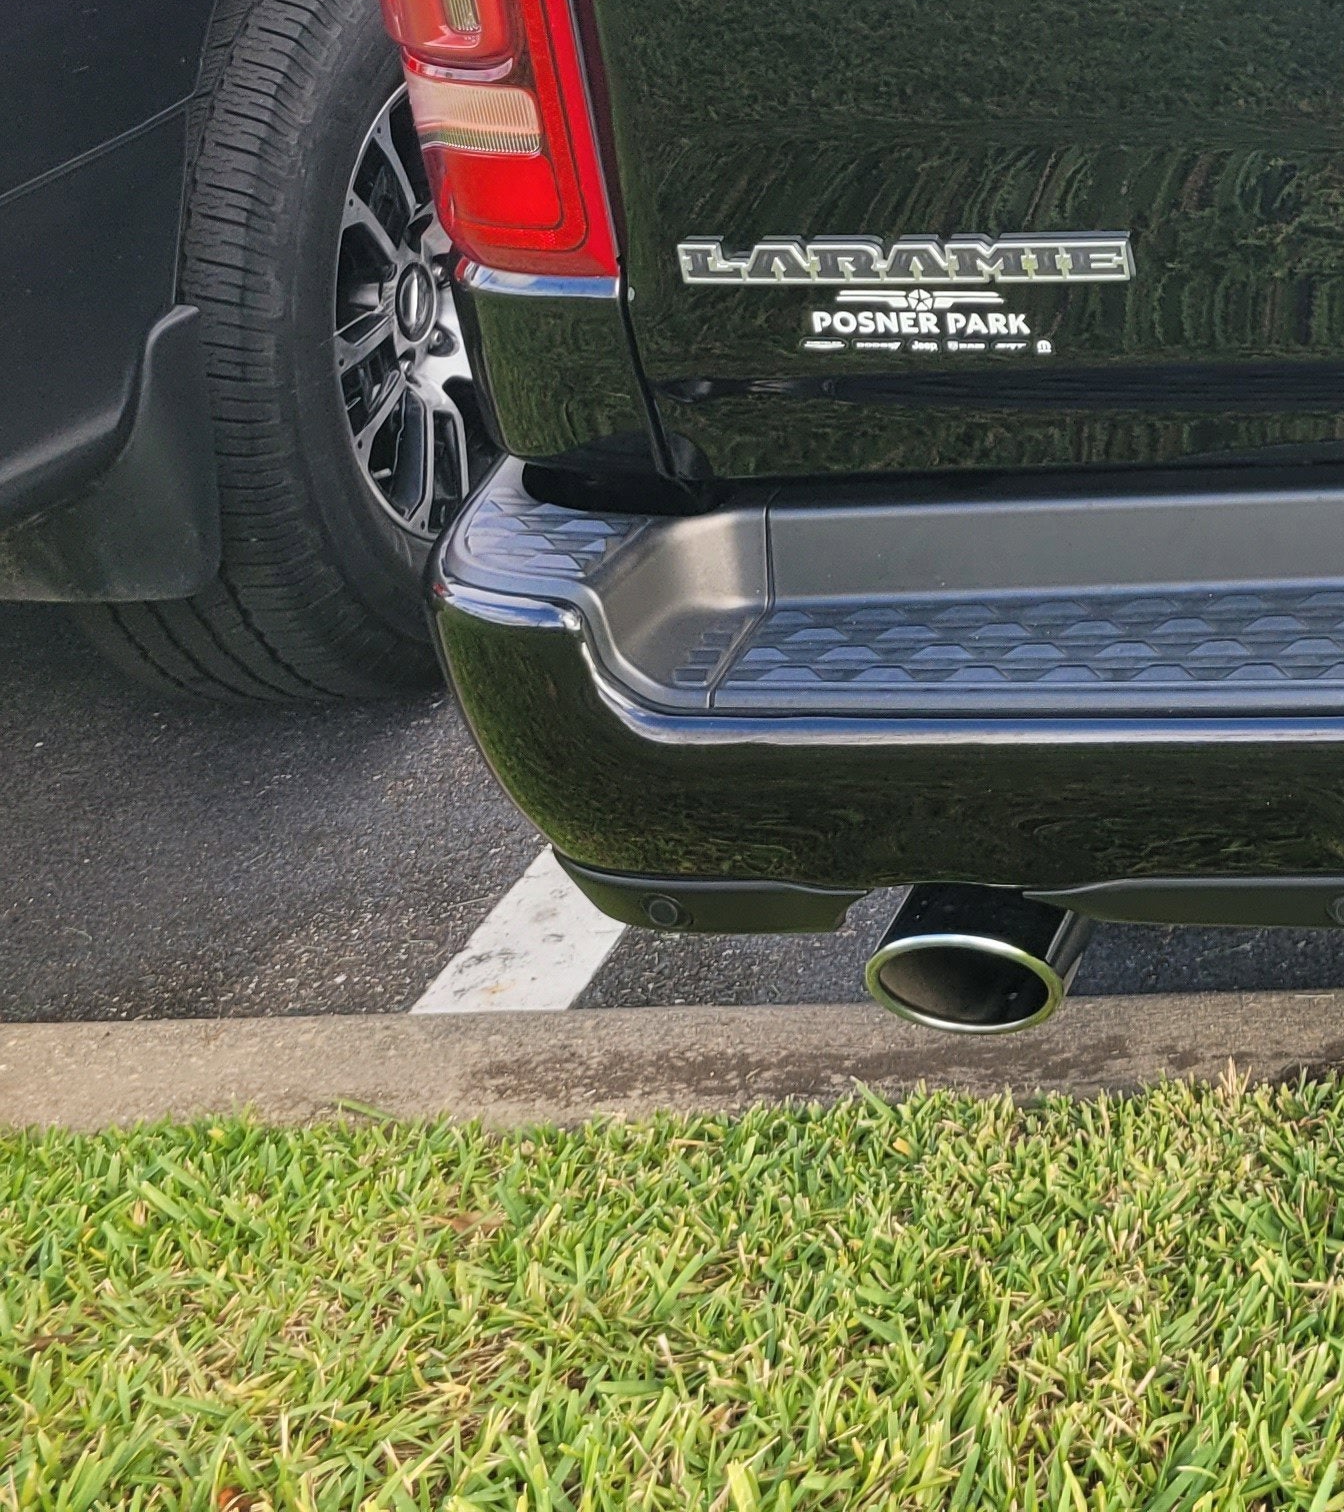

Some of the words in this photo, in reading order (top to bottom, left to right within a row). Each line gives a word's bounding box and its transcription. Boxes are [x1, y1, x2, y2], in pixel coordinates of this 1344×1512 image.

[676, 237, 1133, 285] LARAMIE
[811, 311, 940, 335] POSNER
[946, 311, 1031, 336] PARK
[911, 340, 938, 352] Jeep
